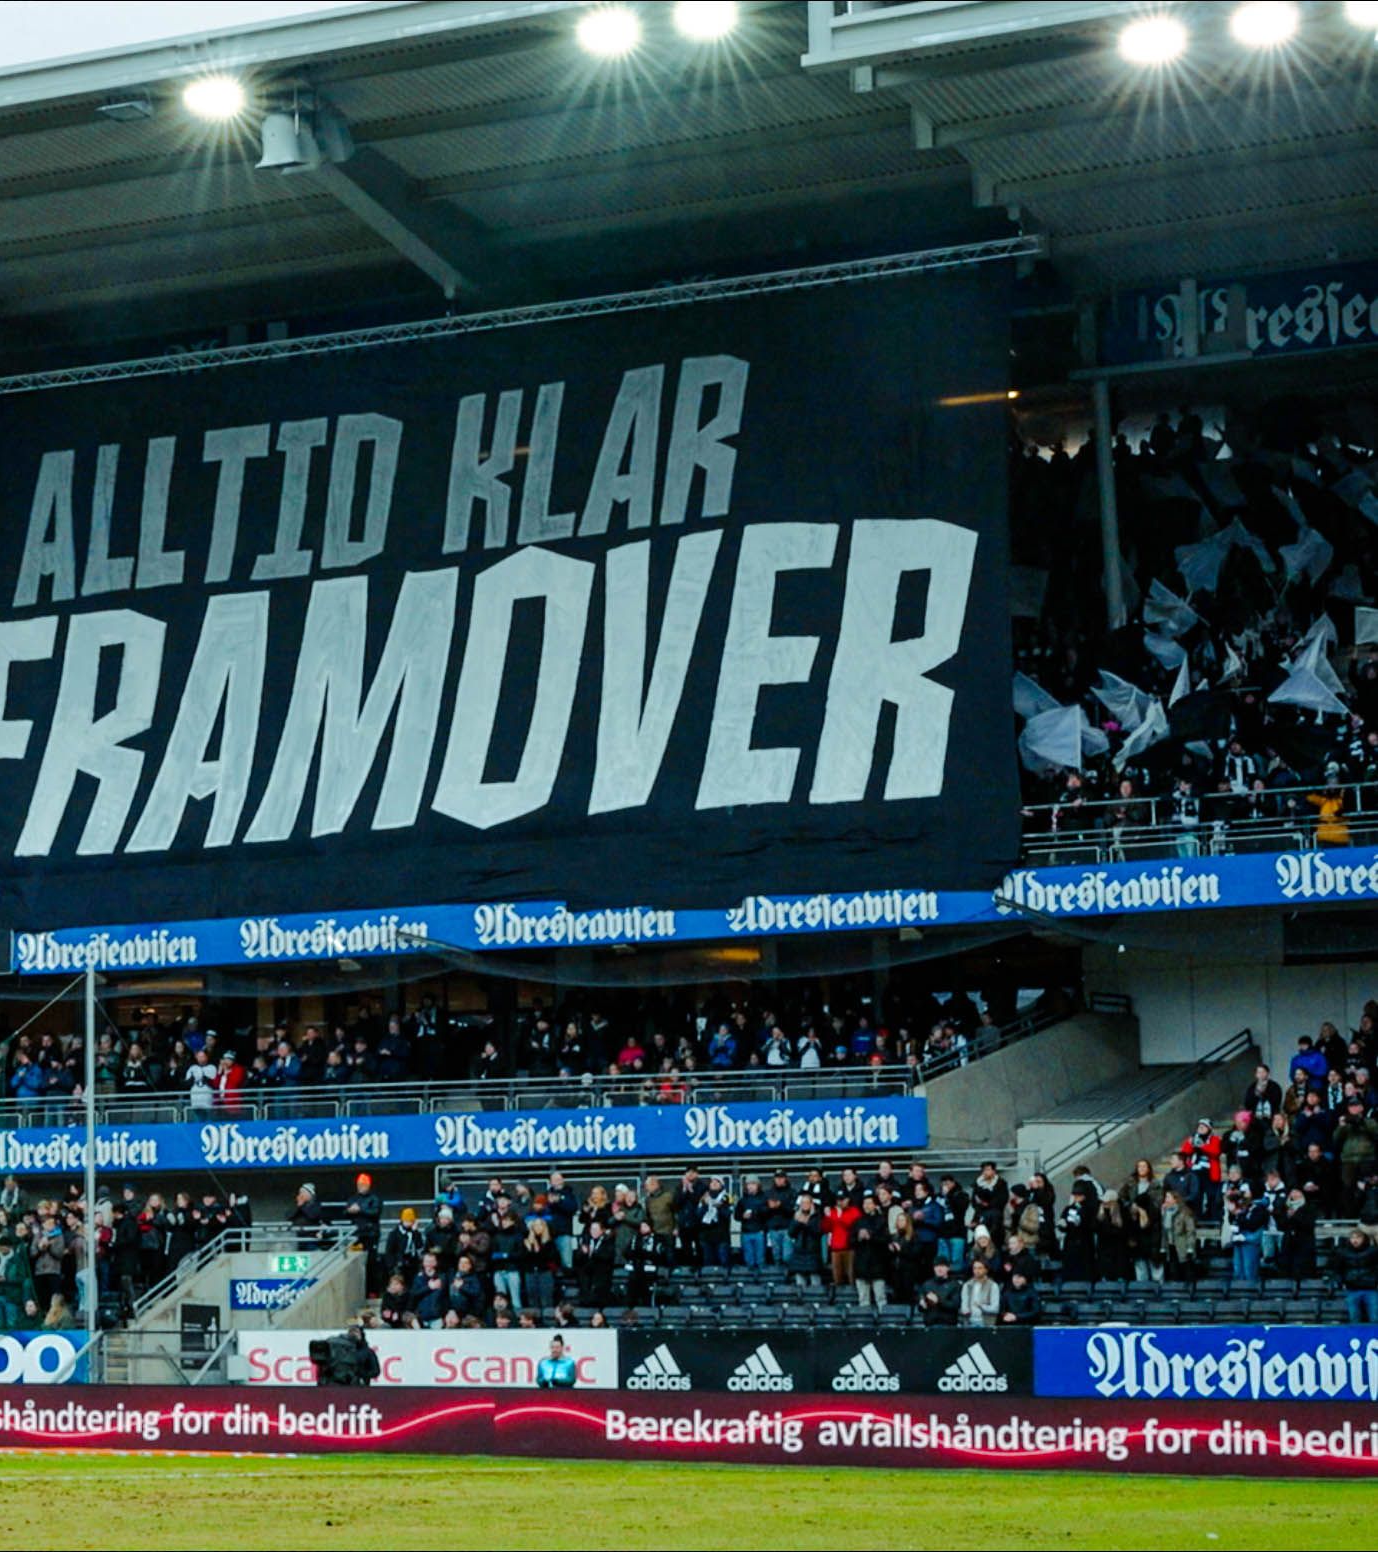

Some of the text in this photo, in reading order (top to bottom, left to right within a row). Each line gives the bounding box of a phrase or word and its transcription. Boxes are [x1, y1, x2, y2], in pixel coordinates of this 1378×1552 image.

[12, 412, 402, 606] ALLTID
[442, 354, 749, 553] KLAR
[474, 903, 676, 947] Adresseavisen
[18, 930, 197, 973] Adresseavisen
[200, 1122, 389, 1169] Adresseavisen
[435, 1114, 637, 1158] Adresseavisen
[684, 1105, 900, 1152] Adresseavisen
[627, 1373, 691, 1391] adidas
[727, 1374, 793, 1391] adidas
[832, 1373, 900, 1391] adidas
[938, 1373, 1008, 1391] adidas
[171, 1403, 215, 1434] for
[223, 1404, 269, 1435] din
[278, 1405, 382, 1436] bedrift
[605, 1408, 804, 1452] Bærekraftig
[818, 1412, 1128, 1461] avfallshåndtering
[1142, 1418, 1197, 1454] for
[1208, 1420, 1267, 1456] din
